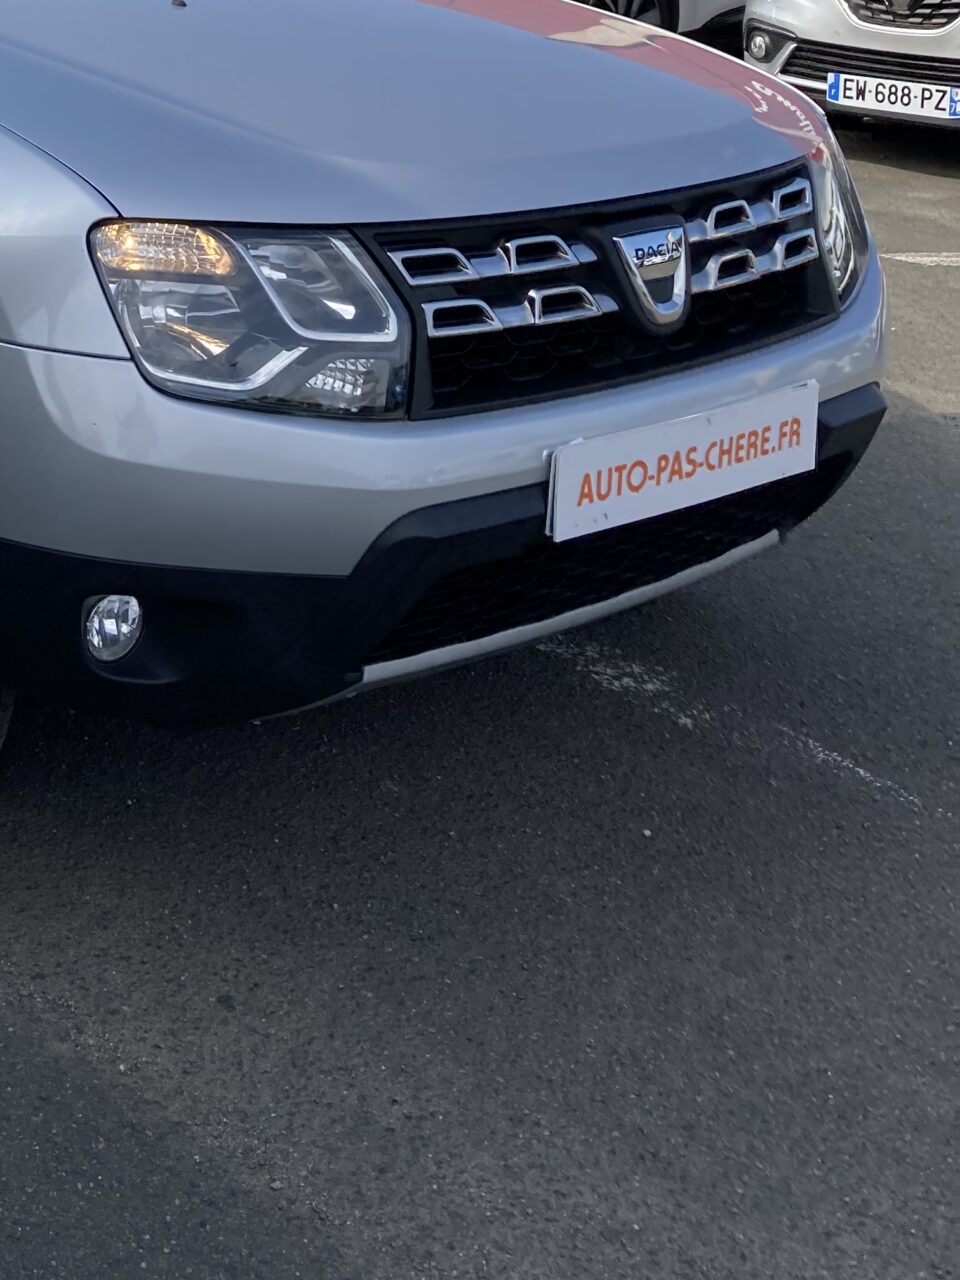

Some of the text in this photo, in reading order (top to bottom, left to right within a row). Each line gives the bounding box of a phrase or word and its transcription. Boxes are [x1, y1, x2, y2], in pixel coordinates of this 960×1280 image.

[842, 77, 948, 112] EW-688-PZ
[634, 241, 680, 261] DACIA
[577, 417, 801, 507] AUTO-PAS-CHERE.FR
